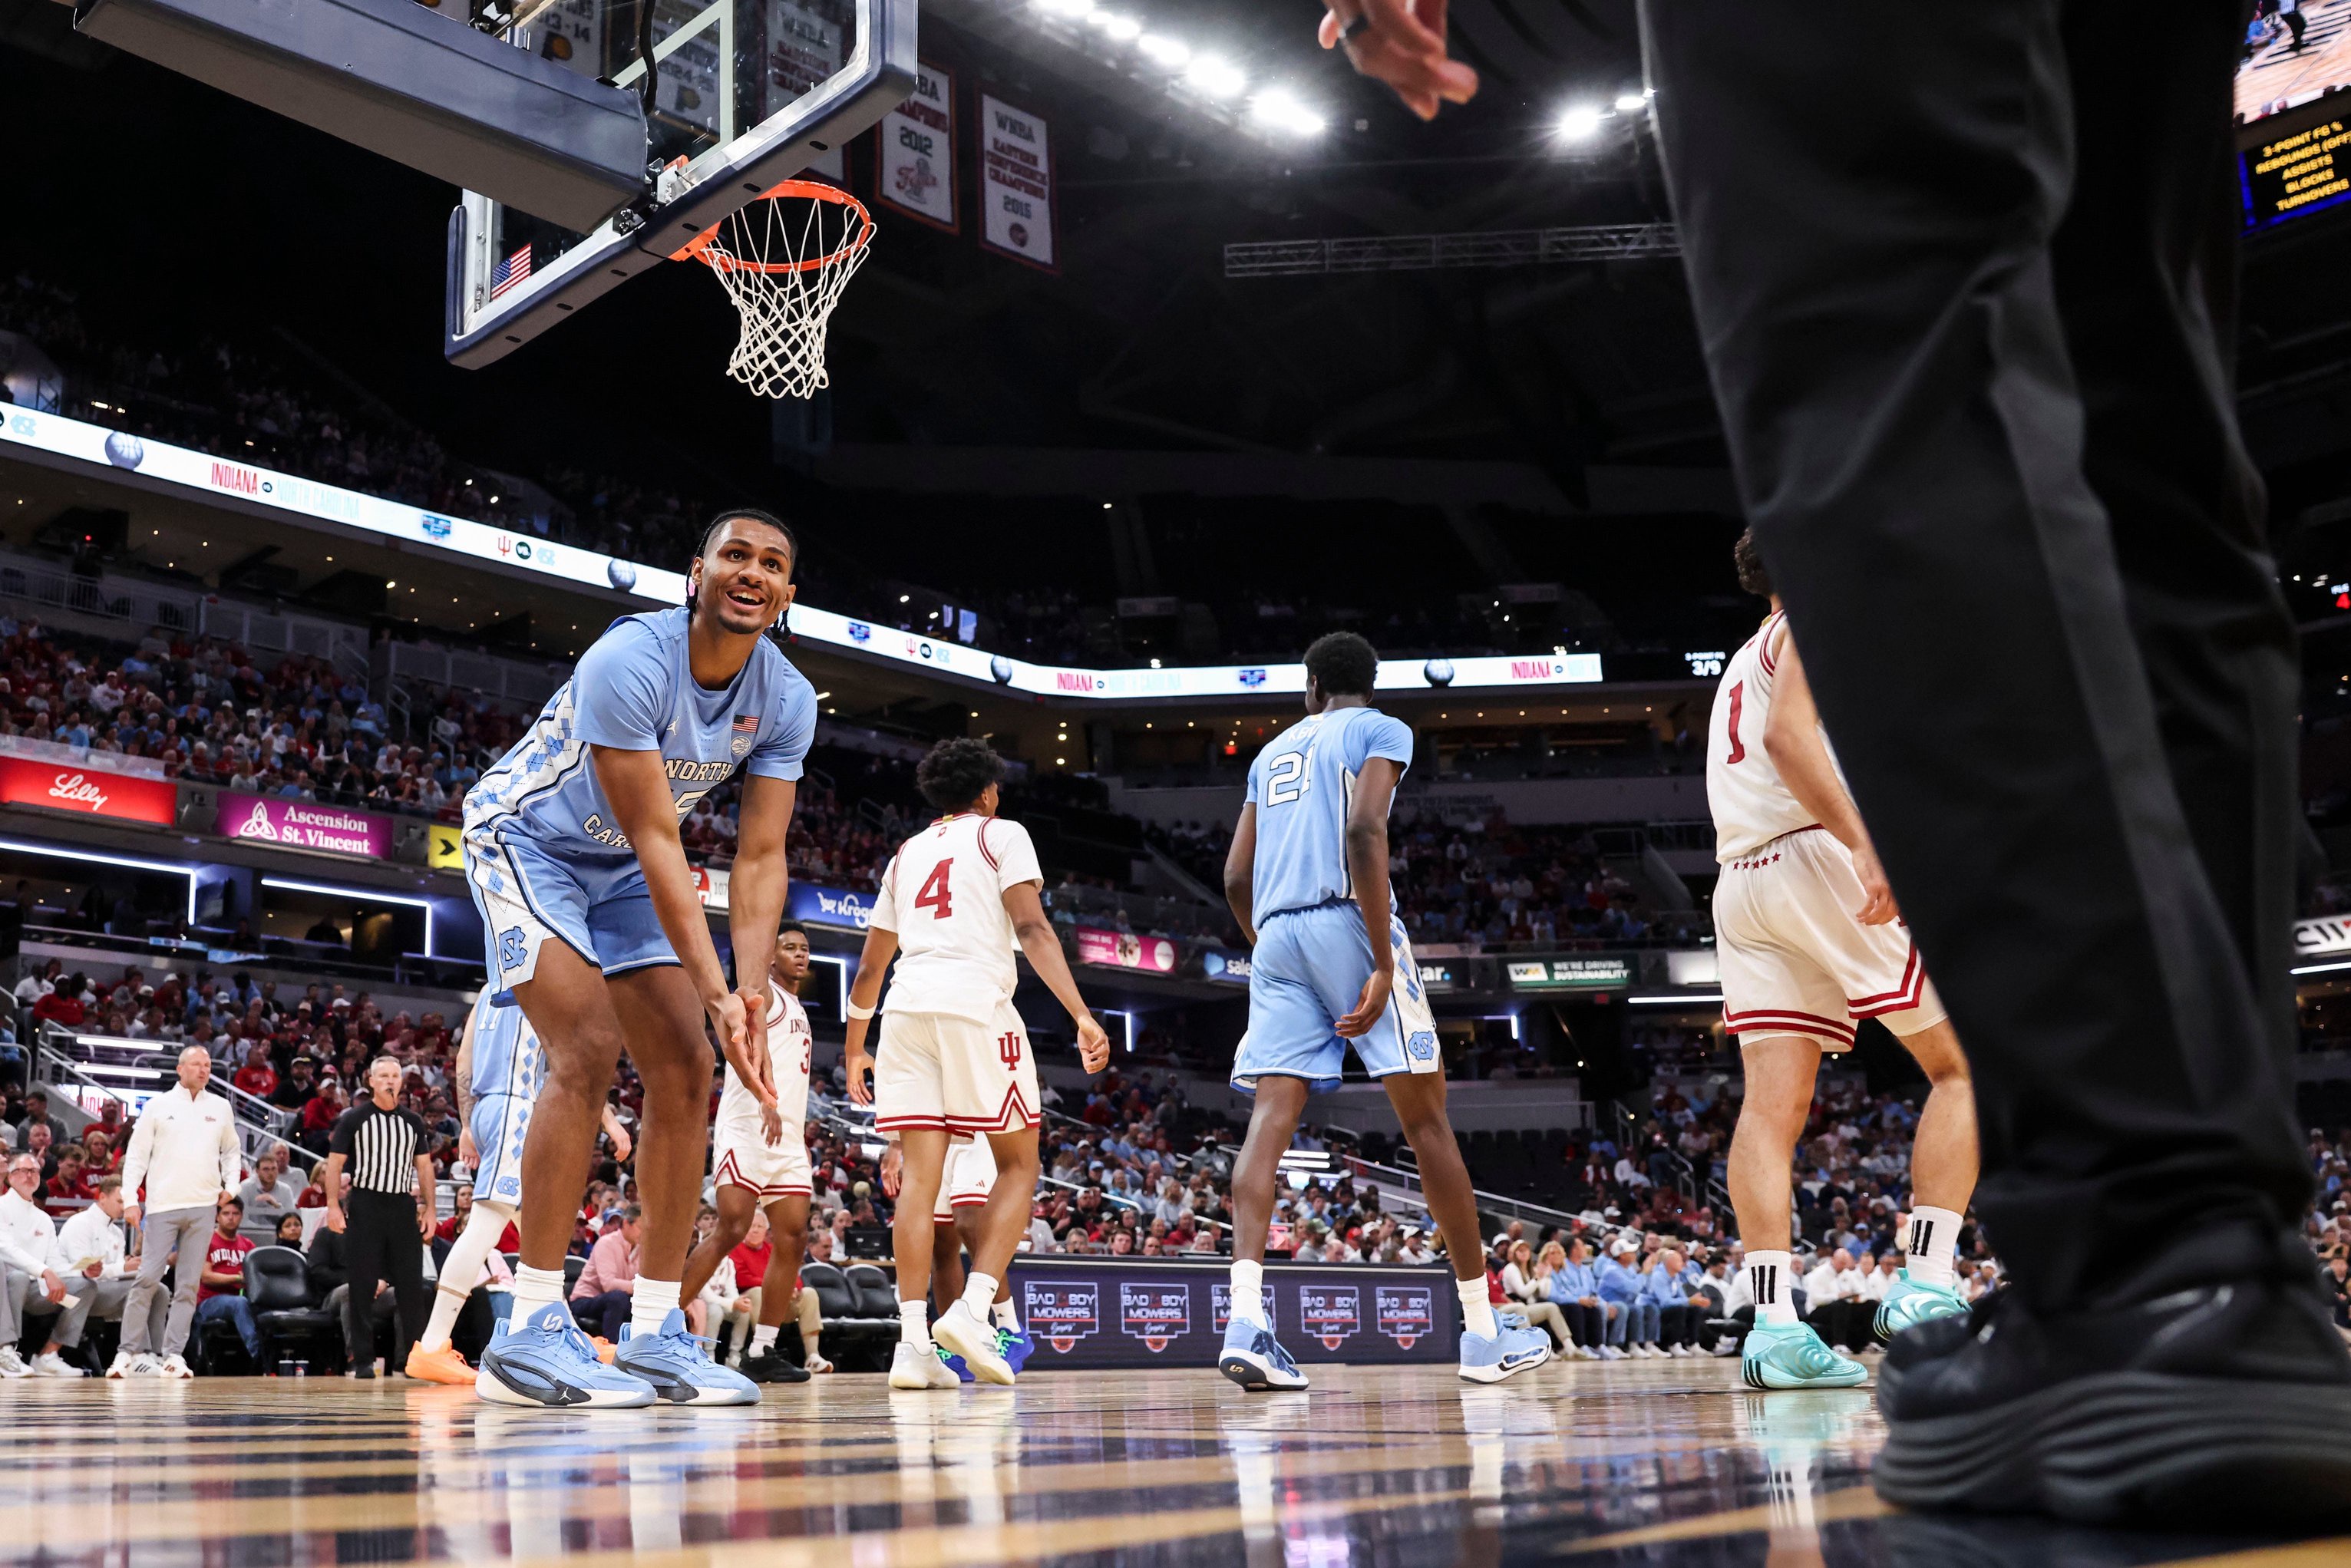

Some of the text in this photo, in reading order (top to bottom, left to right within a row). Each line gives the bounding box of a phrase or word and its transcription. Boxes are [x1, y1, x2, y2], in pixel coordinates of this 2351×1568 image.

[900, 125, 933, 158] 2012
[2255, 143, 2322, 174] REBOUNDS
[2282, 153, 2333, 180] ASSISTS
[2285, 168, 2335, 193] BLOCKS
[2276, 178, 2349, 211] TURNOVERS
[211, 462, 258, 495] INDIANA
[1692, 659, 1722, 676] 3/9
[1057, 672, 1093, 692] INDIANA
[1727, 679, 1745, 764] 1
[664, 759, 733, 781] NORTH
[1266, 743, 1315, 808] 21
[48, 774, 108, 811] Lilly
[283, 806, 368, 834] Ascension
[281, 825, 371, 854] St. Vincent
[915, 857, 954, 919] 4
[837, 894, 873, 928] Krog
[801, 1038, 811, 1074] 3
[210, 1248, 246, 1264] INDIAN
[1028, 1293, 1095, 1306] BAD BOY
[1122, 1294, 1187, 1307] BAD BOY
[1302, 1296, 1357, 1308] BAD BOY
[1378, 1297, 1430, 1308] BAD BOY
[1033, 1307, 1091, 1319] MOWERS
[1129, 1308, 1182, 1319] MOWERS
[1307, 1308, 1353, 1319] MOWERS
[1383, 1309, 1426, 1319] MOWERS
